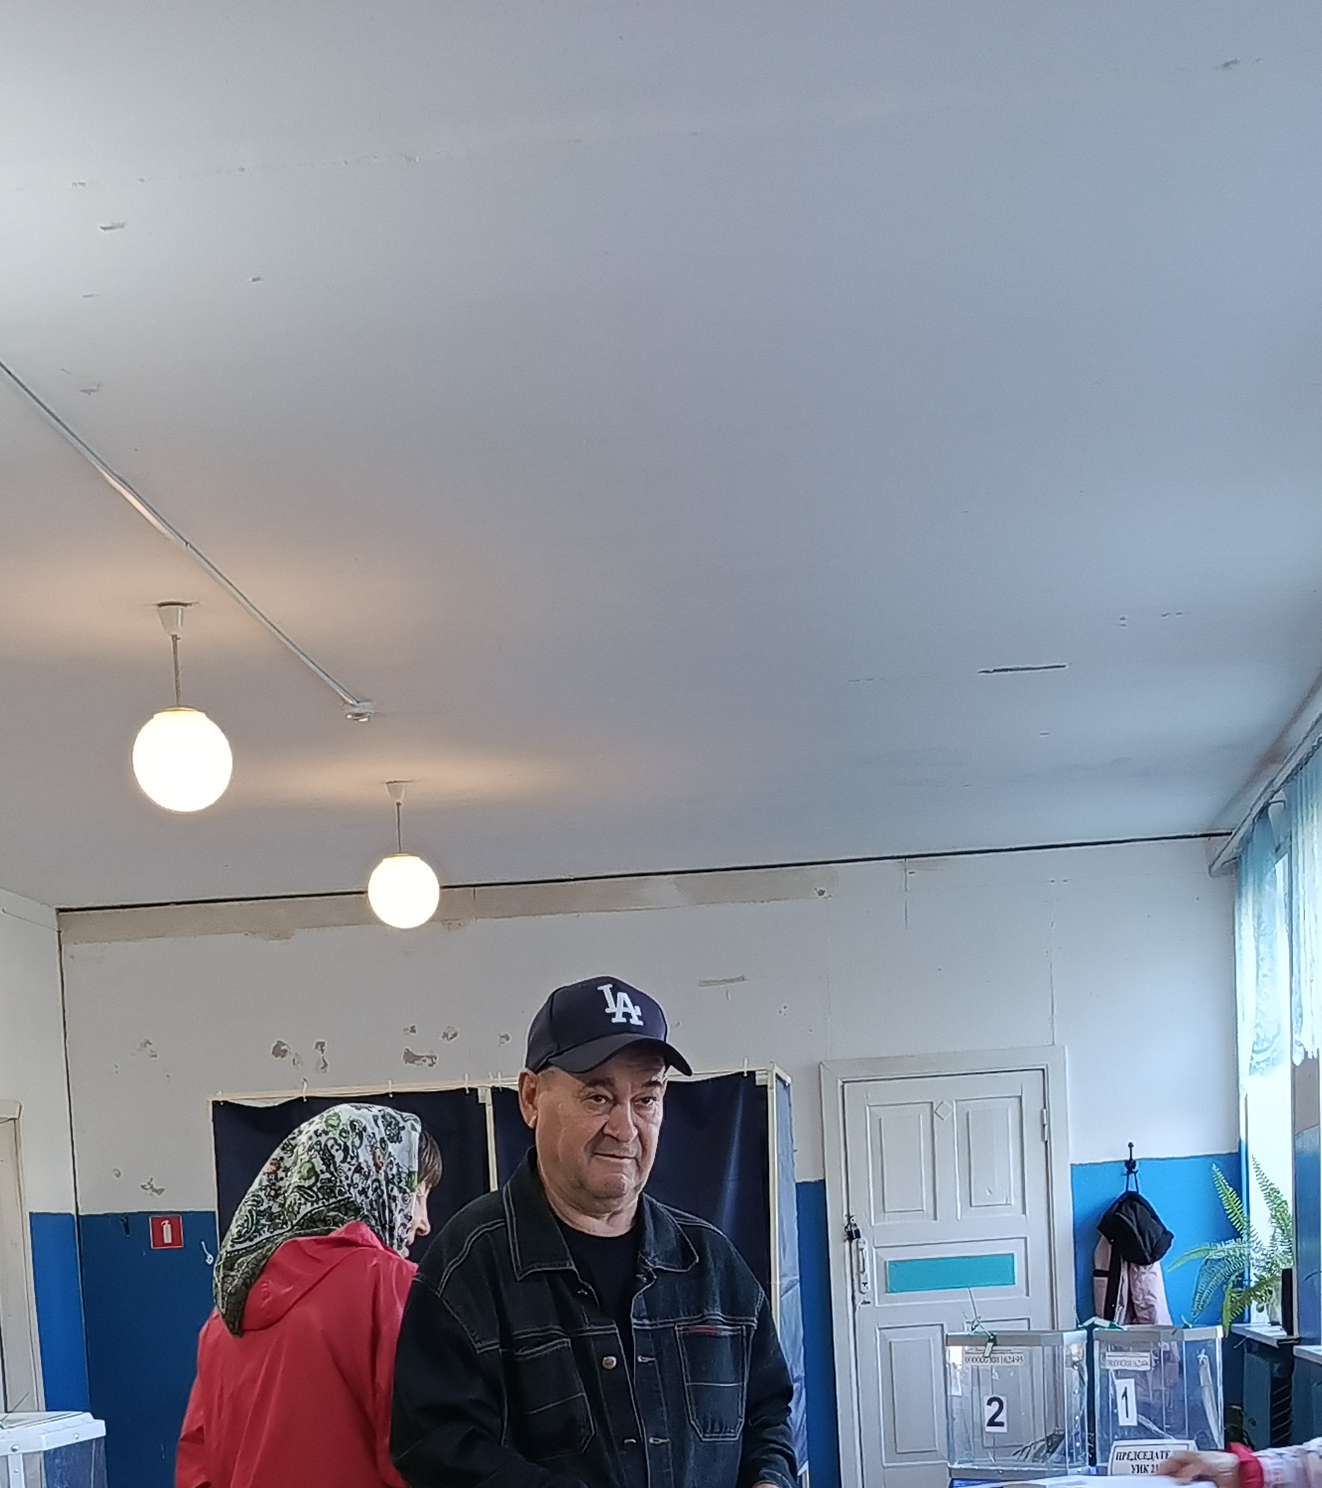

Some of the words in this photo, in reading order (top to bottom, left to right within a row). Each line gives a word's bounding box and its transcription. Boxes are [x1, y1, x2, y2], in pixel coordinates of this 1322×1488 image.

[597, 983, 644, 1026] LA
[986, 1396, 1005, 1427] 2
[1121, 1386, 1129, 1419] 1
[1115, 1450, 1171, 1462] ПРЕДСЕДАТЕ
[1130, 1463, 1150, 1475] УИК
